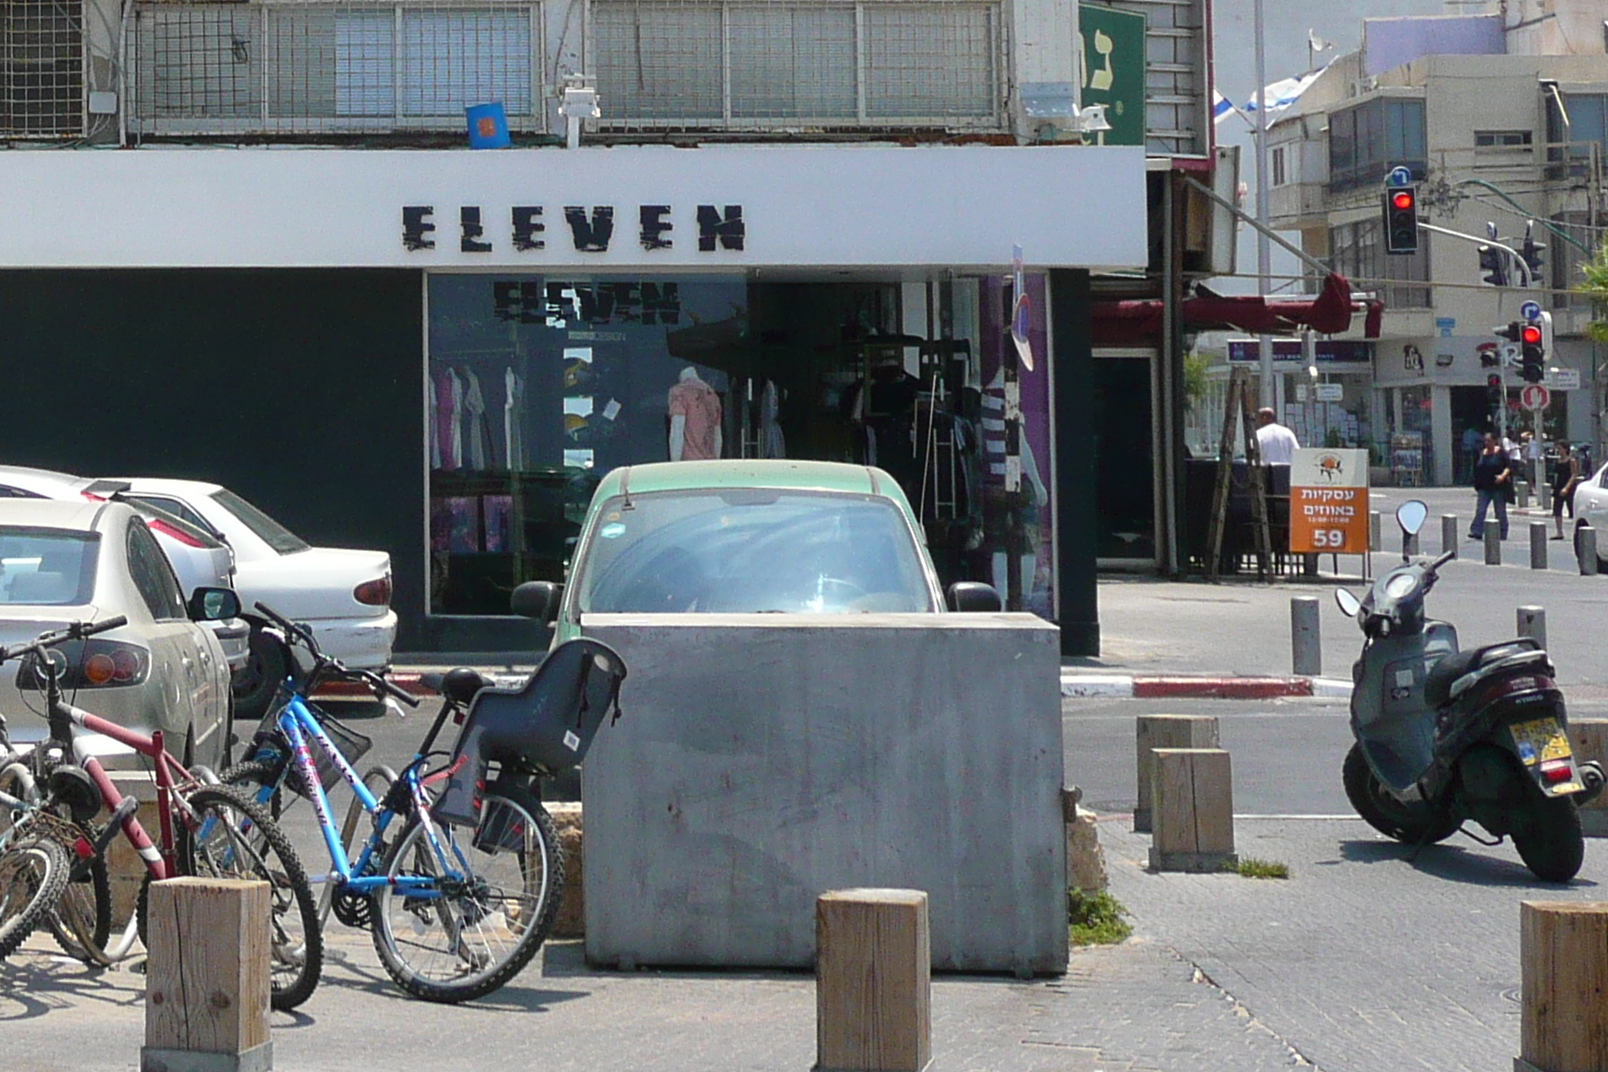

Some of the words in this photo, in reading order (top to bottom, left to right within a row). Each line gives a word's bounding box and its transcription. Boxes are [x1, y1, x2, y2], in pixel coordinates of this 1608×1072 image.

[402, 205, 745, 252] ELEVEN
[1301, 490, 1354, 502] עסקיות
[1314, 530, 1343, 546] 59
